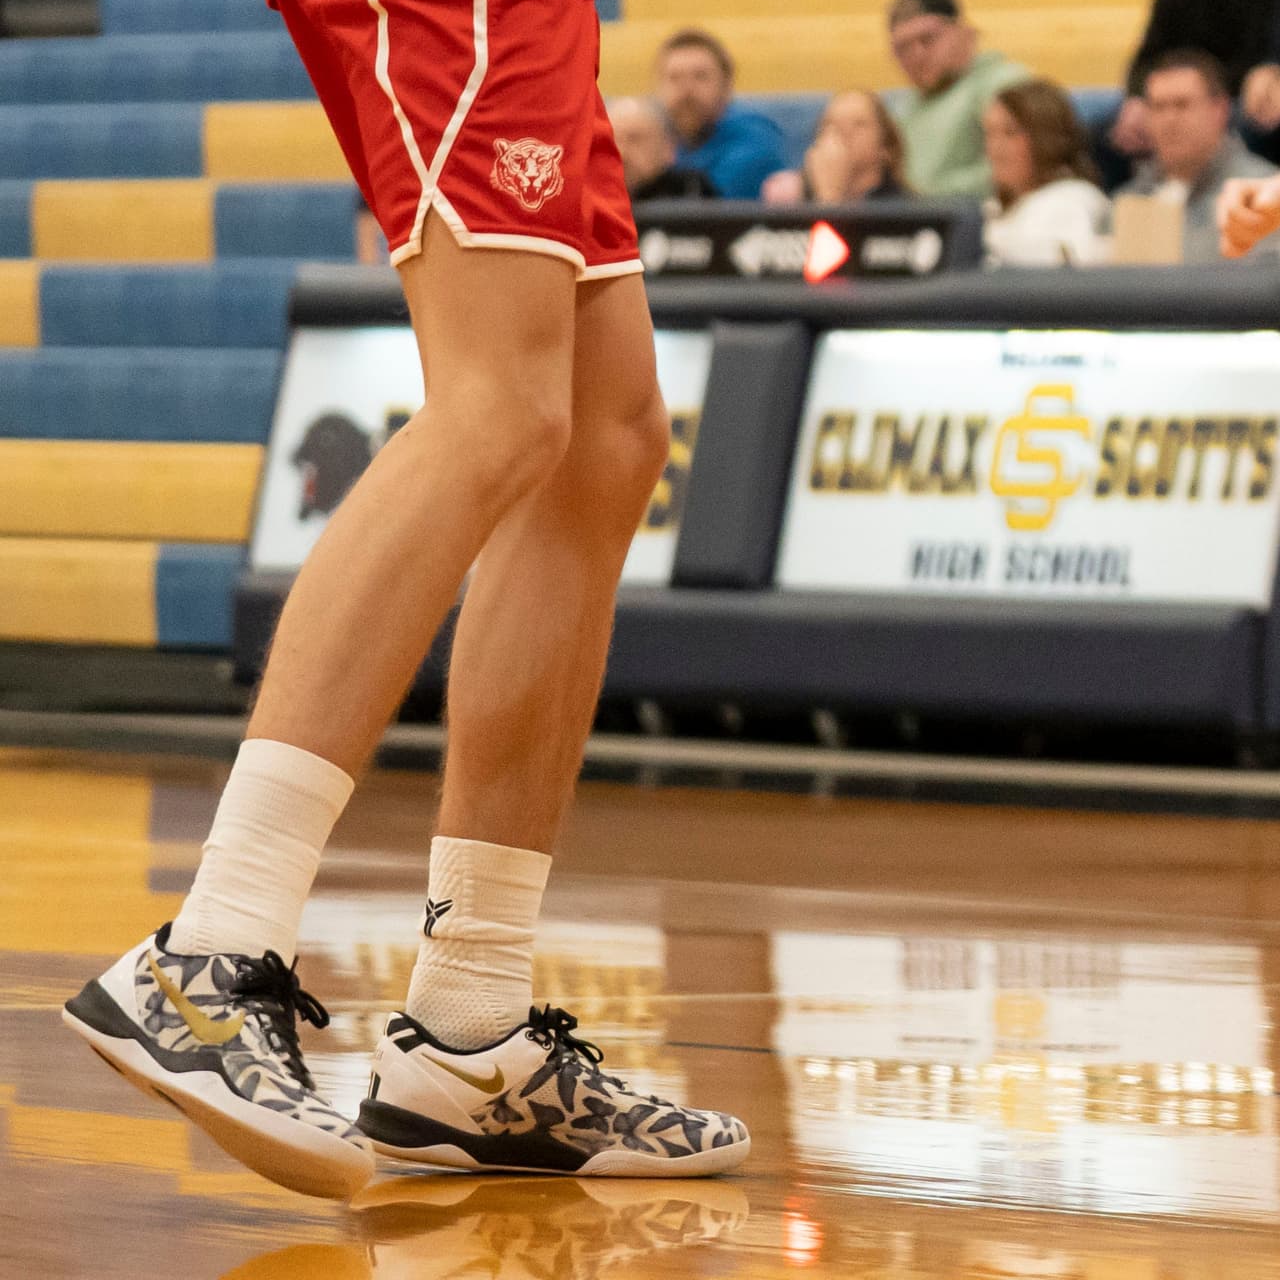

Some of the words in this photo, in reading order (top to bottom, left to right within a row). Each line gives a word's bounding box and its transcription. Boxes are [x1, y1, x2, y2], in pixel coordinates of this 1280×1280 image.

[810, 410, 988, 496] CLIMAX
[909, 541, 986, 580] HIGH
[1004, 545, 1134, 586] SCHOOL
